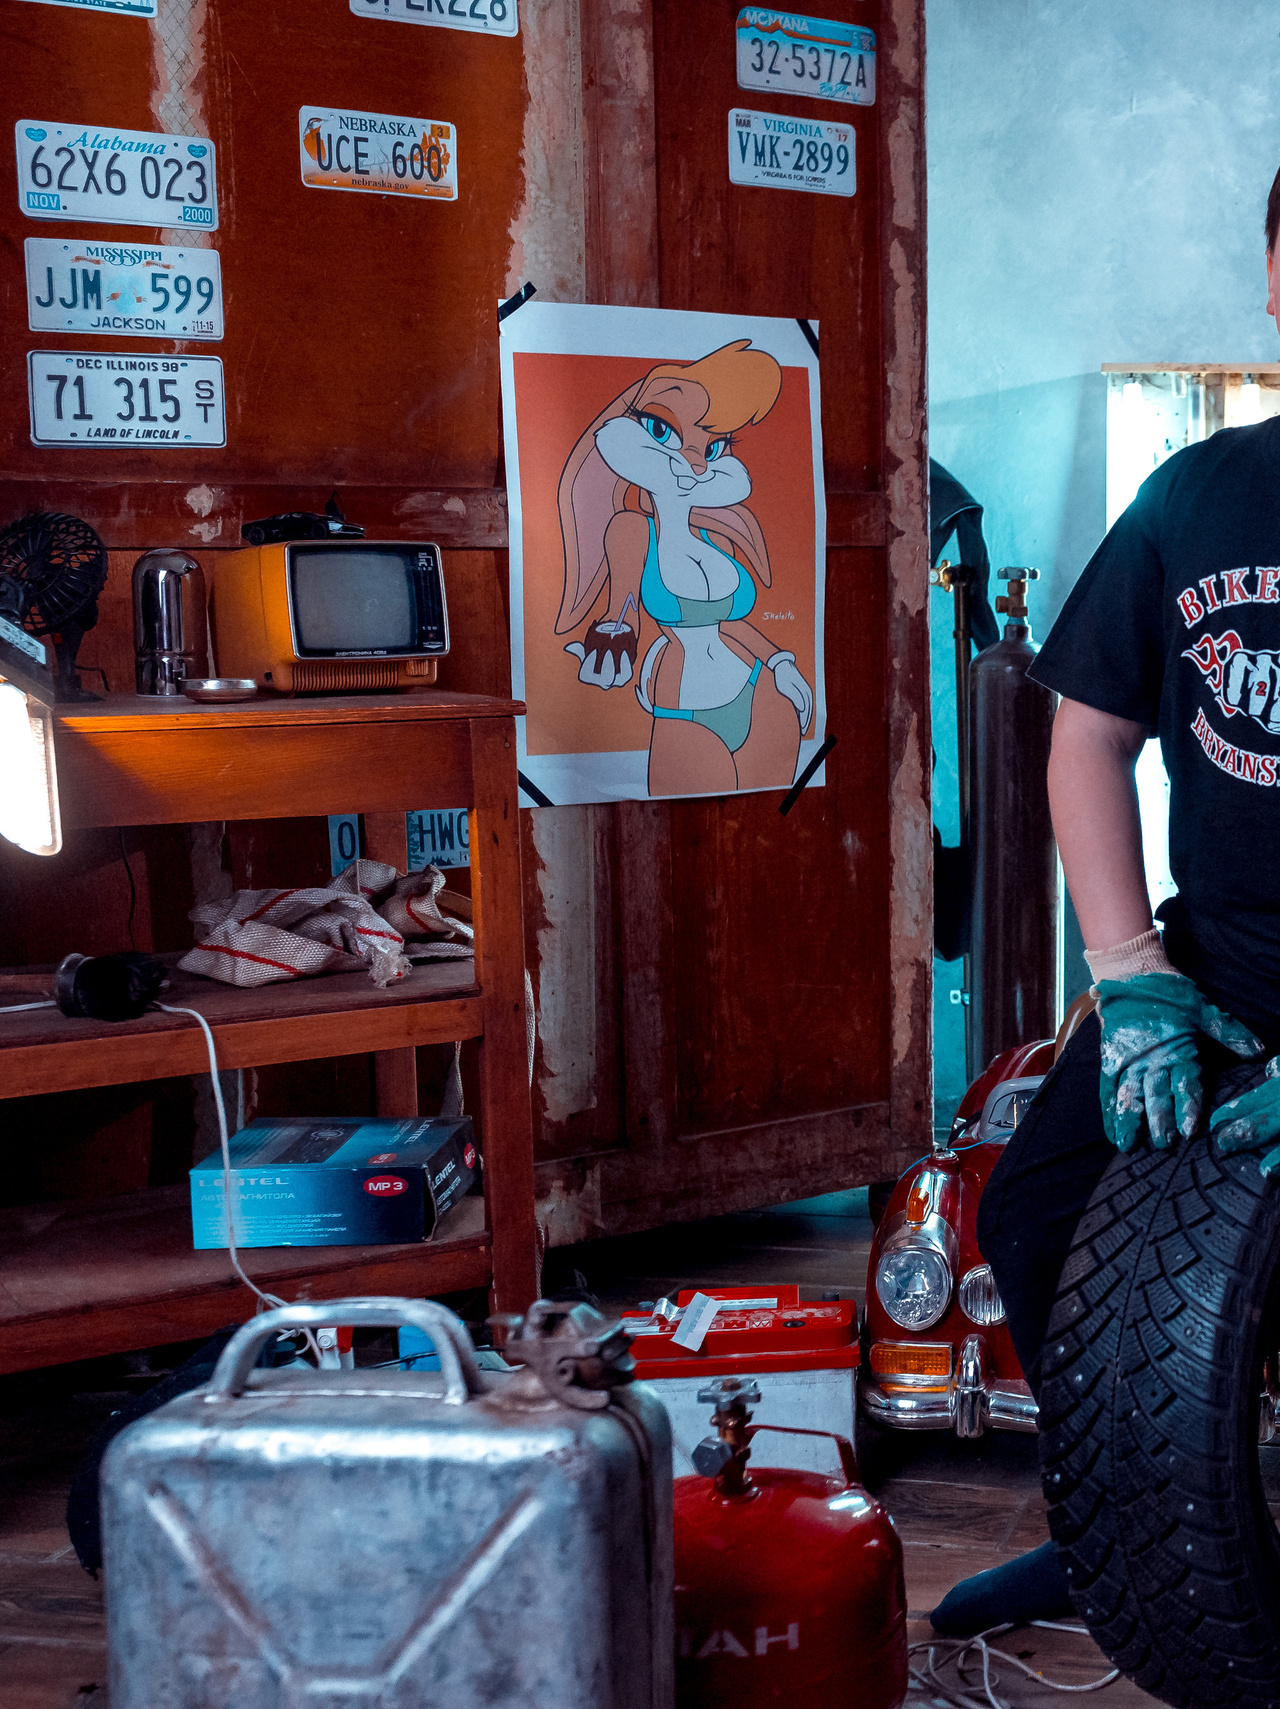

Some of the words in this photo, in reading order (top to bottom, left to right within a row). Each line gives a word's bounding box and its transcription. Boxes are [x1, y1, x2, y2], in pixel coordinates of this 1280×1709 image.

[338, 116, 417, 137] NEBRASKA
[437, 126, 444, 137] 3
[763, 118, 823, 138] VIRGINIA
[67, 132, 167, 155] Alabama
[837, 134, 848, 142] 17
[316, 132, 370, 175] UCE
[392, 141, 442, 182] 600
[737, 130, 849, 175] VMK-2899
[31, 145, 126, 196] 62X6
[140, 156, 207, 204] 023
[351, 177, 410, 191] nebraska.gov
[29, 195, 59, 208] NOV
[184, 208, 211, 222] 2000
[86, 247, 162, 266] MISSISSIPPI
[35, 267, 102, 310] JJM
[151, 273, 214, 315] 599
[91, 317, 166, 331] JACKSON
[76, 359, 102, 370] DEC
[106, 360, 158, 372] ILLINOIS
[162, 362, 179, 372] 98
[47, 375, 93, 420] 71
[114, 377, 180, 423] 315
[87, 428, 116, 438] LAND
[119, 429, 134, 438] OF
[135, 429, 180, 440] LINCOLN
[1256, 681, 1266, 696] 2
[431, 1159, 456, 1190] LENTEL
[201, 1192, 296, 1201] АВТАГНИТОЛА
[677, 1622, 799, 1658] АН
